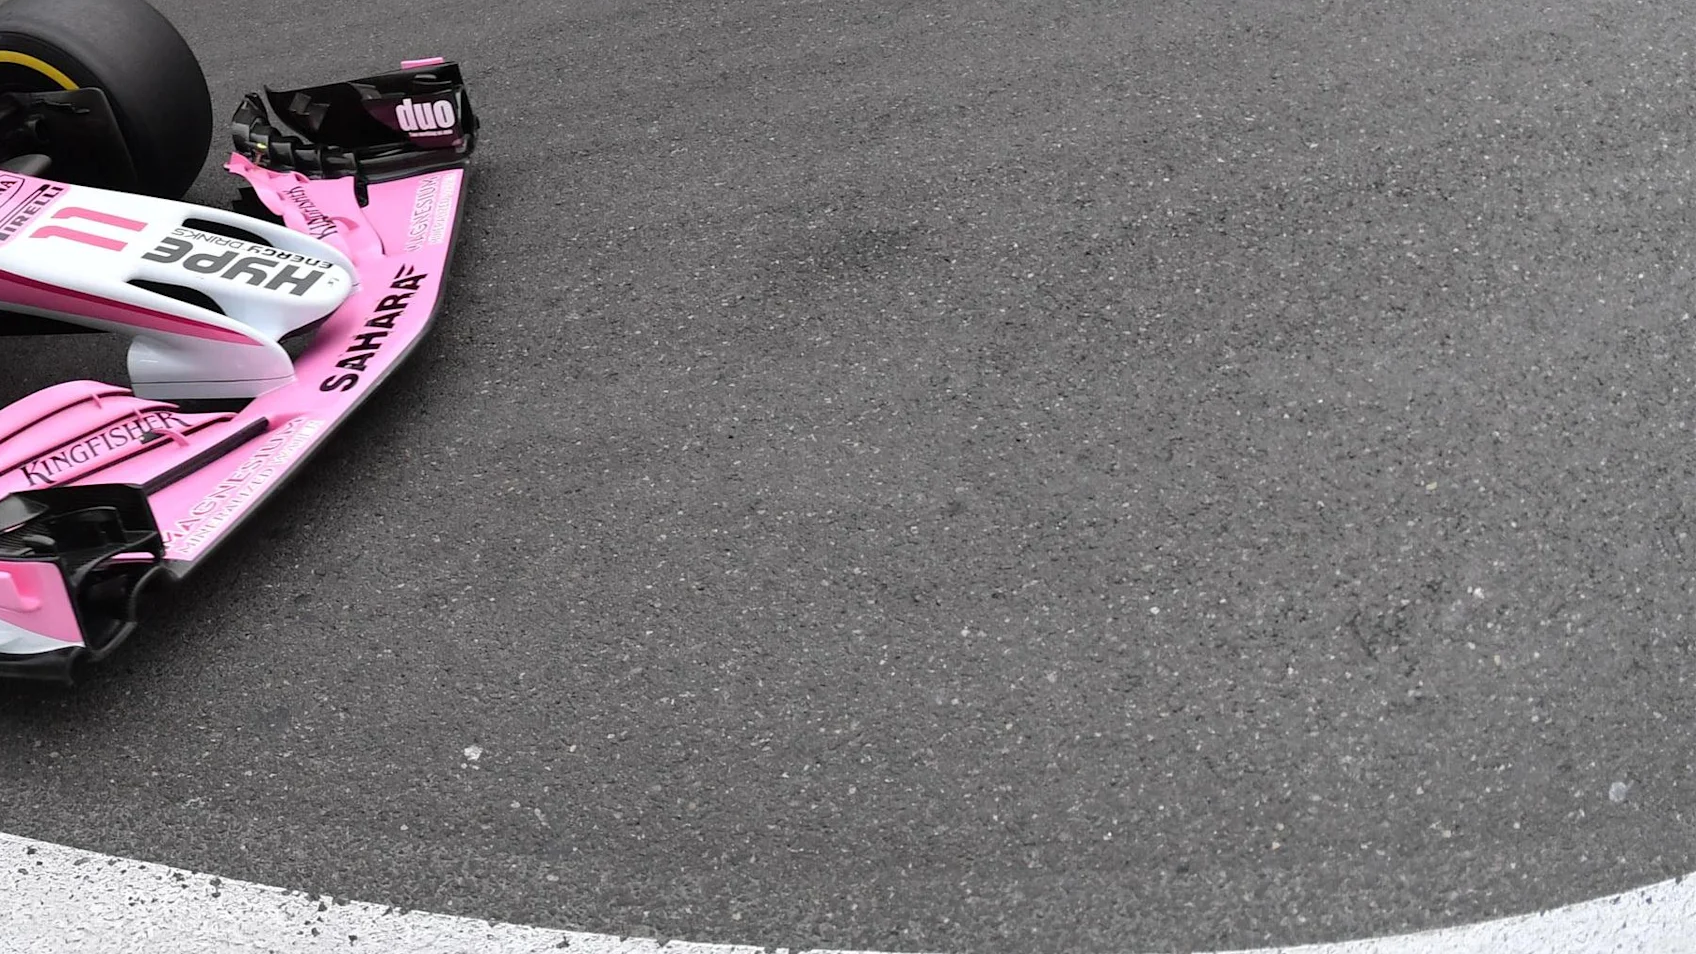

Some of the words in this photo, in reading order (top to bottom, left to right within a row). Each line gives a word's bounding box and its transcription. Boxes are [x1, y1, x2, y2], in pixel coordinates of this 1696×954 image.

[395, 98, 456, 131] duo
[28, 206, 148, 252] 11
[170, 227, 243, 252] DRINKS
[141, 236, 324, 296] HYPE
[319, 272, 429, 392] SAHARA
[20, 411, 192, 487] KINGFISHER
[163, 417, 304, 549] MAGNESIUM
